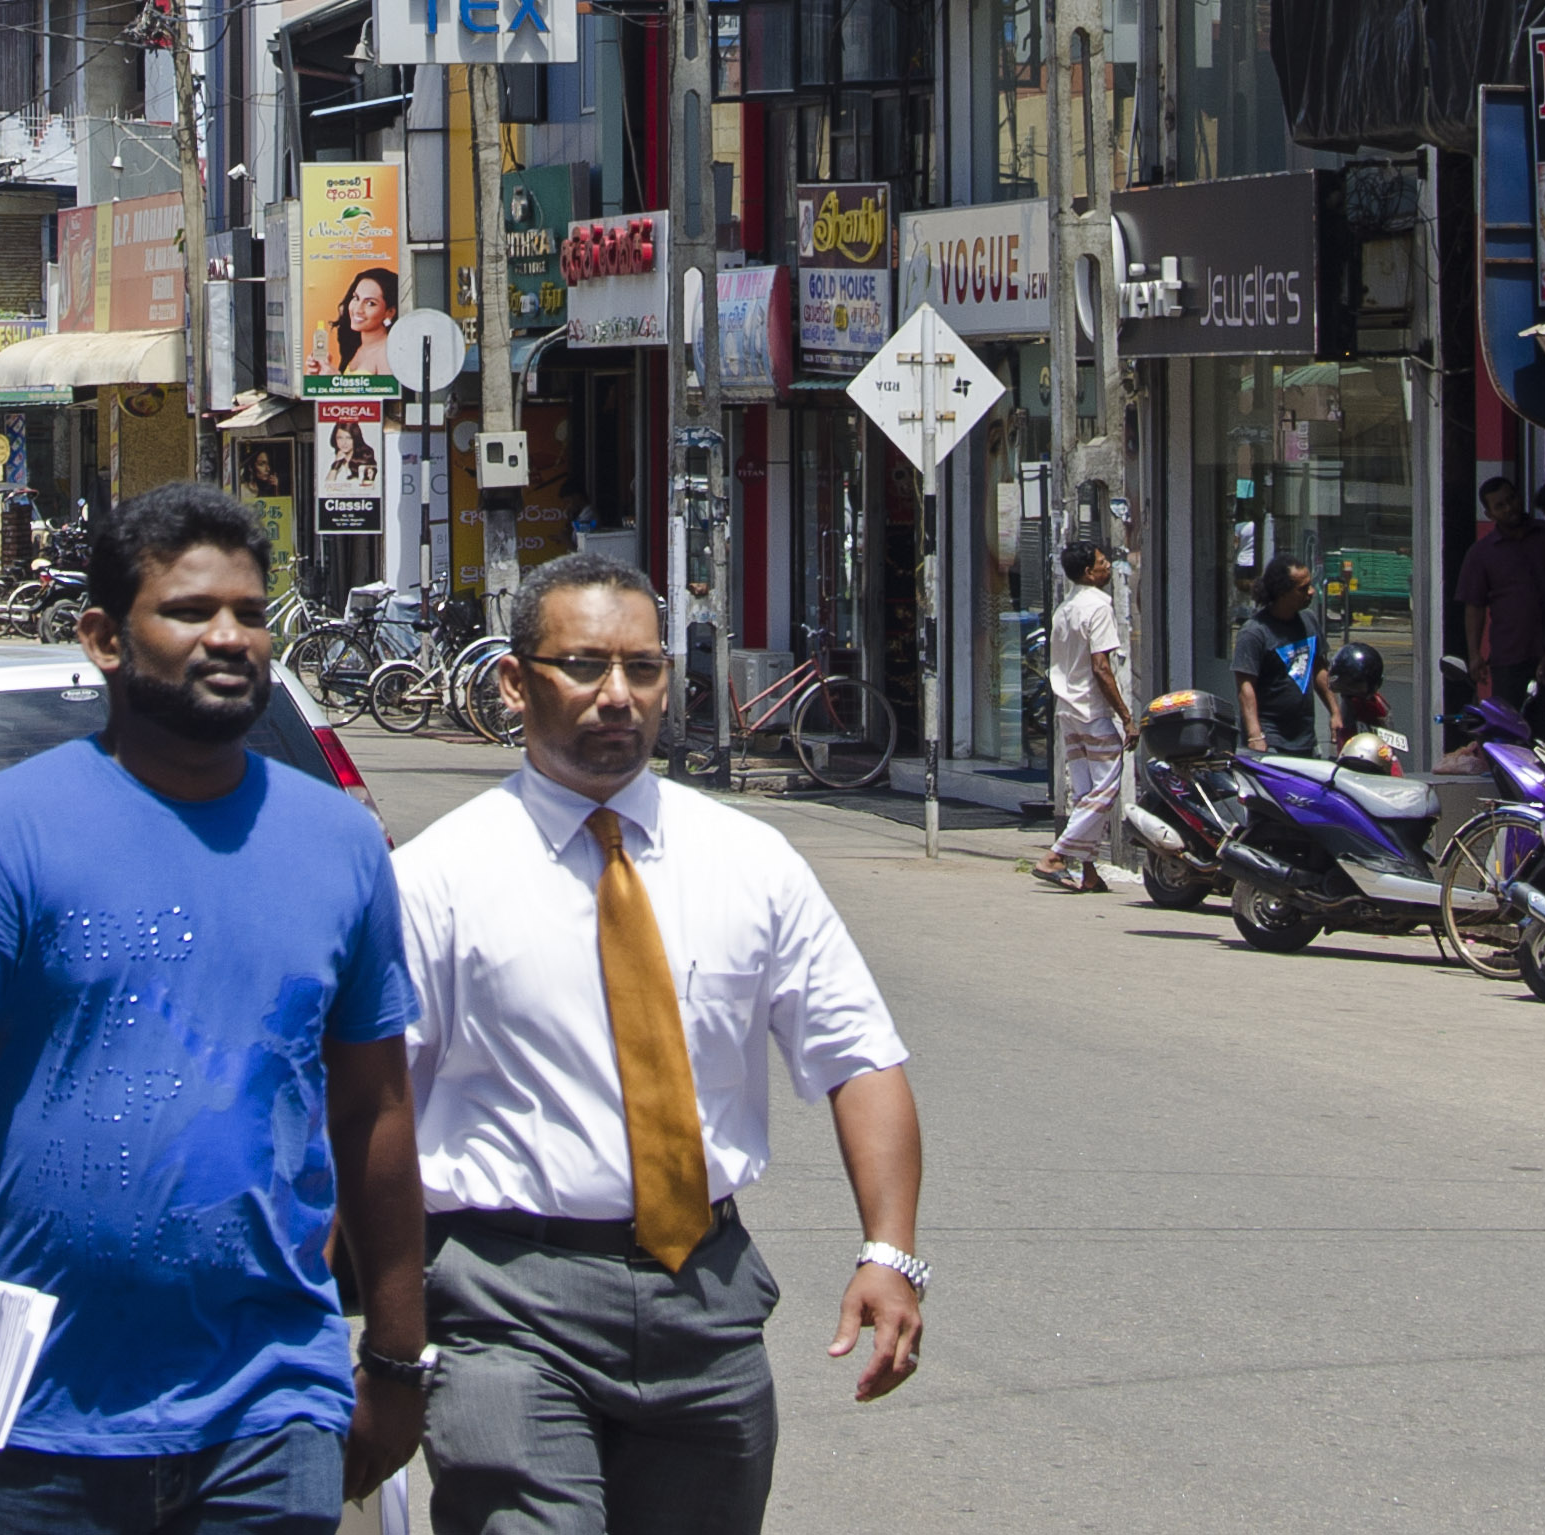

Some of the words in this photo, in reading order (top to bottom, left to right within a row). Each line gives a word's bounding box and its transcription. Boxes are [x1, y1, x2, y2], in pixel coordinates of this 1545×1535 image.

[813, 189, 885, 263] Shanthi
[939, 235, 1019, 305] VOGUE
[809, 273, 836, 300] GOLD
[839, 275, 876, 302] HOUSE
[332, 376, 370, 387] Classic
[737, 469, 766, 478] TITAN
[325, 499, 373, 511] Classic
[41, 1064, 183, 1121] POP
